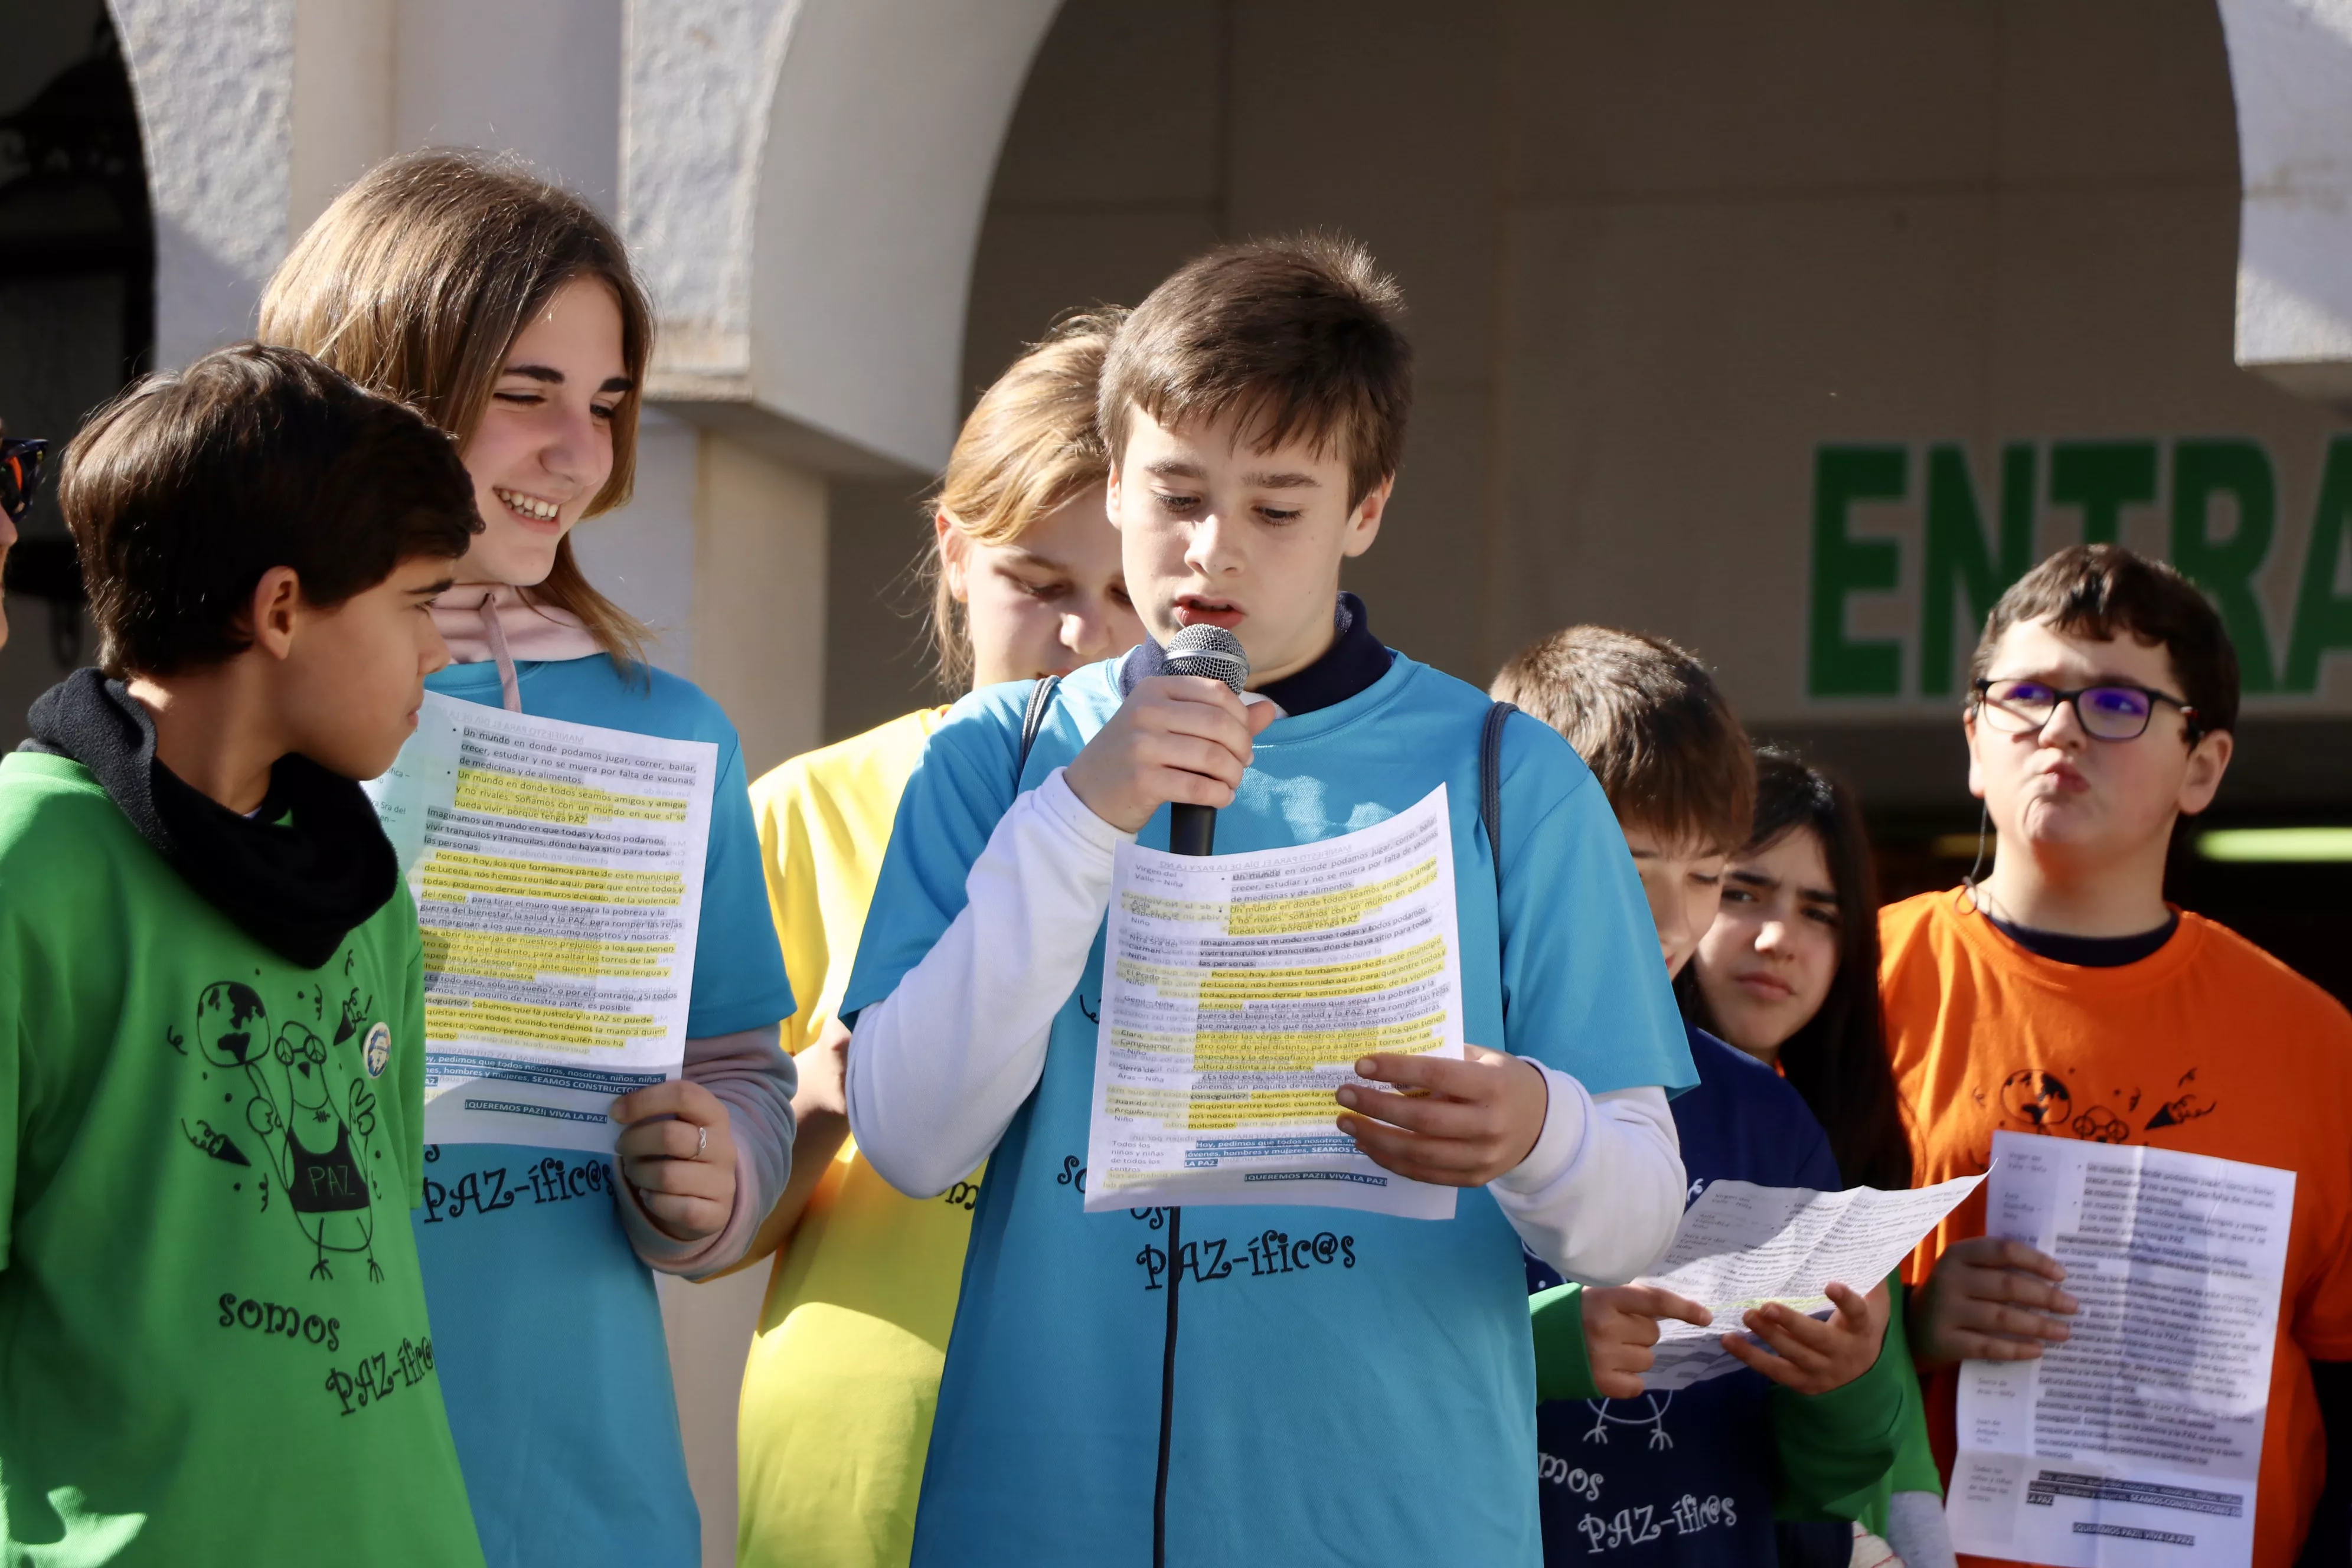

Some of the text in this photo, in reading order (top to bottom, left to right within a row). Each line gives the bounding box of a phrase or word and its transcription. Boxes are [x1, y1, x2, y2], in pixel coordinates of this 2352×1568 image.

[462, 743, 489, 756] crecer,
[494, 749, 528, 762] estudiar
[533, 757, 537, 765] y
[569, 763, 597, 772] muera
[601, 767, 615, 776] por
[620, 766, 639, 778] falta
[643, 770, 654, 780] de
[658, 775, 695, 786] vacunas,
[463, 727, 475, 737] Un
[479, 733, 509, 744] mundo
[530, 739, 557, 752] donde
[562, 747, 602, 760] podamos
[605, 752, 631, 765] jugar,
[636, 759, 664, 770] correr,
[669, 760, 696, 773] bailar,
[460, 754, 583, 783] de medicinas y de alimentos.
[456, 785, 461, 793] y
[481, 788, 510, 800] rivales.
[515, 793, 554, 806] Soñamos
[594, 805, 625, 815] mundo
[645, 811, 661, 820] que
[665, 810, 671, 819] sí
[458, 770, 469, 779] Un
[473, 775, 503, 785] mundo
[521, 779, 548, 792] donde
[551, 784, 575, 796] todos
[579, 790, 611, 801] seamos
[615, 795, 645, 806] amigos
[649, 799, 654, 808] y
[656, 798, 687, 810] amigas
[394, 805, 406, 814] del
[427, 807, 479, 823] Imaginamos
[496, 819, 527, 829] mundo
[543, 827, 558, 835] que
[561, 826, 586, 837] todas
[589, 831, 594, 840] y
[596, 829, 620, 840] todos
[623, 832, 664, 844] podamos
[455, 799, 481, 809] pueda
[484, 802, 504, 814] vivir,
[508, 808, 538, 818] porque
[541, 809, 566, 822] tenga
[424, 834, 436, 844] las
[426, 821, 669, 856] vivir tranquilos y tranquilas, dónde haya sitio para todas
[1265, 879, 1299, 888] estudiar
[1340, 867, 1365, 876] muera
[1368, 861, 1381, 871] por
[1384, 853, 1400, 863] falta
[1414, 832, 1438, 849] vacunas,
[1244, 892, 1288, 901] medicinas
[1311, 883, 1354, 894] alimentos.
[439, 1054, 476, 1064] pedimos
[498, 1058, 522, 1069] todos
[525, 1064, 566, 1076] nosotros,
[568, 1069, 607, 1081] nosotras,
[610, 1072, 635, 1083] niños,
[639, 1073, 664, 1083] niñas,
[444, 1065, 482, 1076] hombres
[492, 1070, 530, 1083] mujeres,
[533, 1076, 570, 1086] SEAMOS
[465, 1102, 521, 1111] ¡QUEREMOS
[523, 1106, 546, 1115] PAZ!¡
[550, 1110, 571, 1119] VIVA
[308, 1165, 356, 1196] PAZ
[1136, 1230, 1355, 1290] PAZ-ífic@s
[325, 1336, 434, 1416] PAZ-ífic@
[1538, 1452, 1604, 1501] mos
